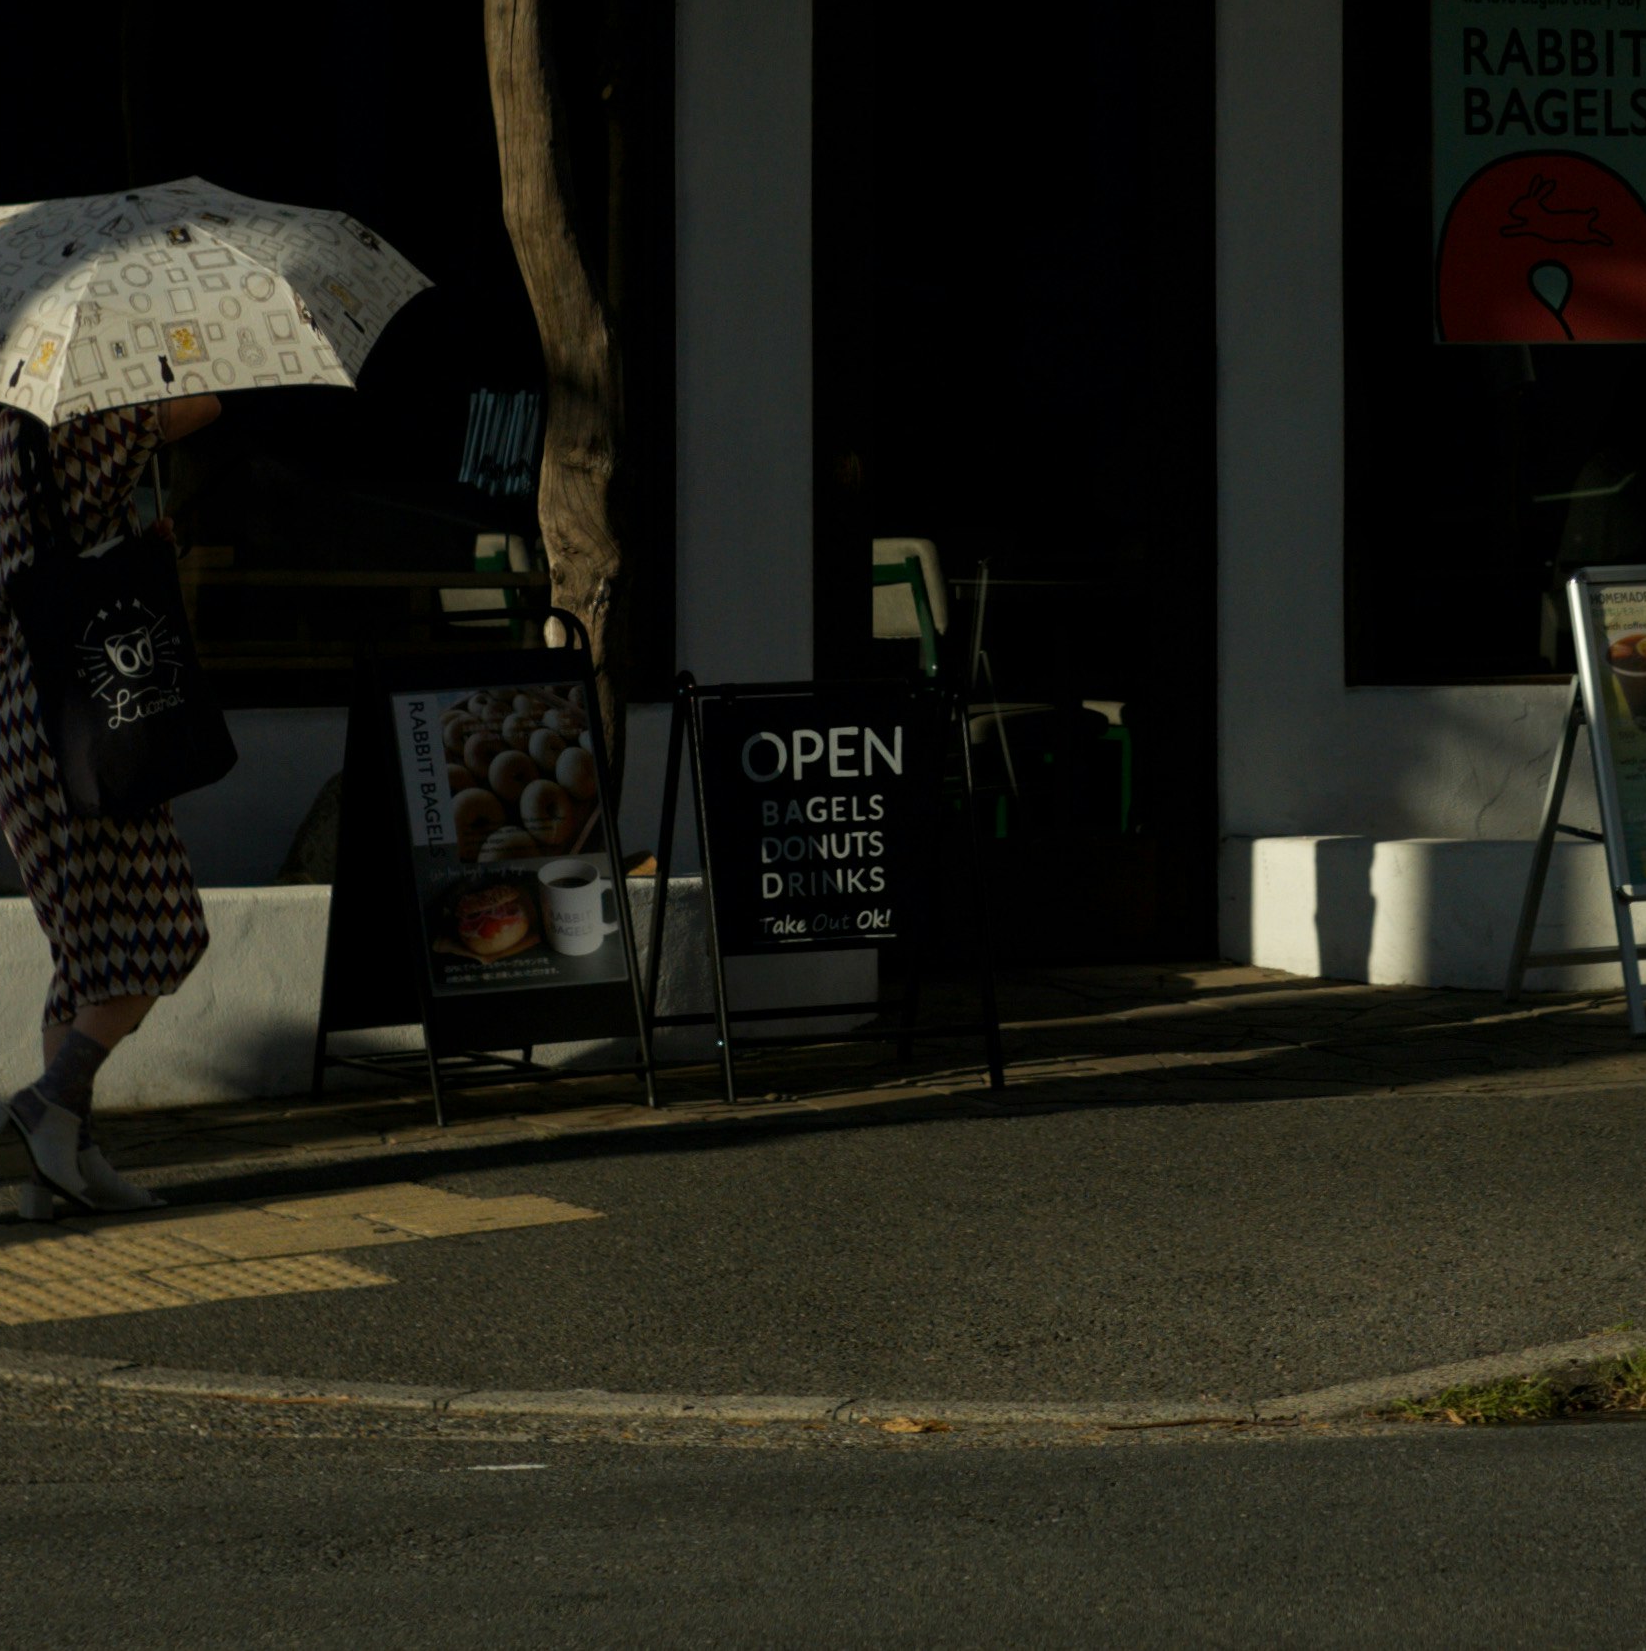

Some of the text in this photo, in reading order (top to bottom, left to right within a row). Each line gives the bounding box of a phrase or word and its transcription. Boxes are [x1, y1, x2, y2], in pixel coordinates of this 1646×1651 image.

[741, 725, 903, 783] OPEN
[407, 701, 448, 859] RABBIT BAGELS
[761, 794, 885, 827] BAGELS
[761, 830, 885, 865] DONUTS
[761, 865, 886, 900] DRINKS
[760, 908, 893, 936] Take Out Ok!
